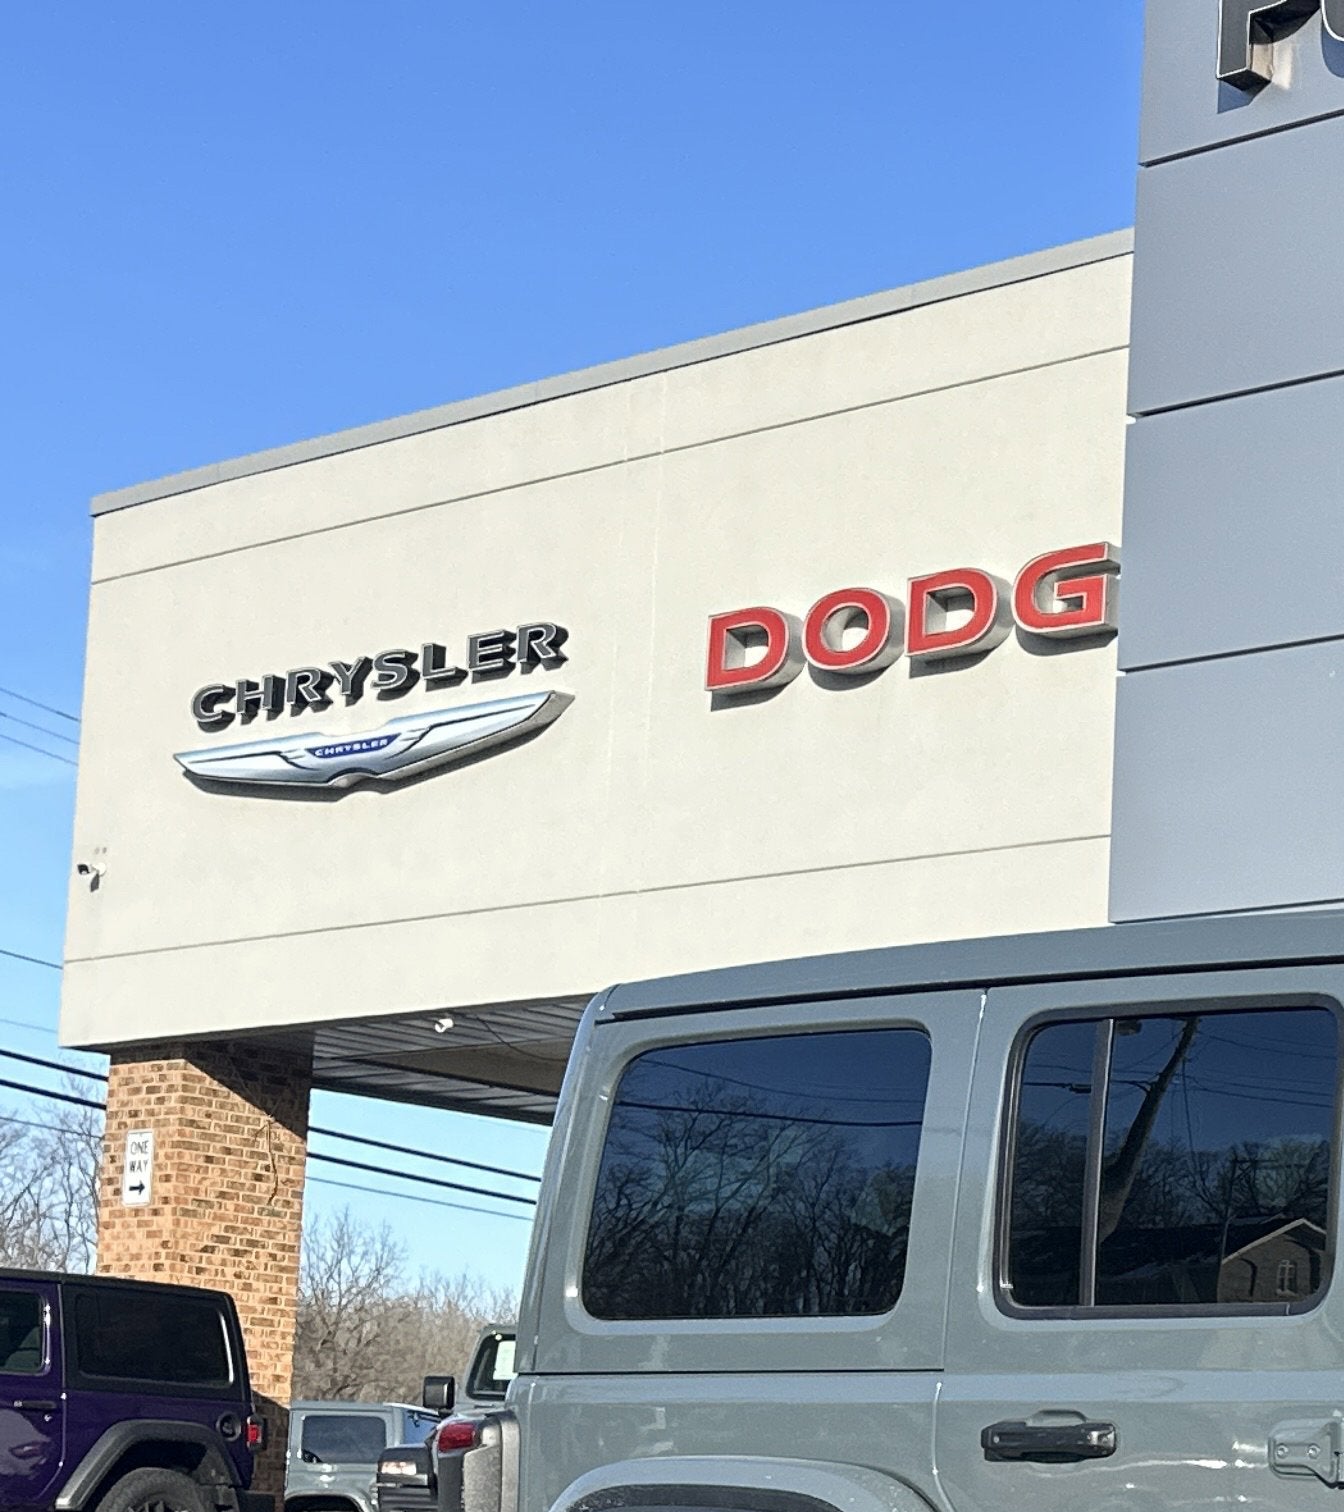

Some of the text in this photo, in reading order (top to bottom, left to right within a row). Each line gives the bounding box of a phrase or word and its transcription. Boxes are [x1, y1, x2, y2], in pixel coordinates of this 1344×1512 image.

[705, 541, 1113, 693] DODG
[191, 622, 562, 726] CHRYSLER
[315, 739, 388, 756] CHRYSLER
[130, 1140, 149, 1155] ONE
[129, 1160, 148, 1173] WAY
